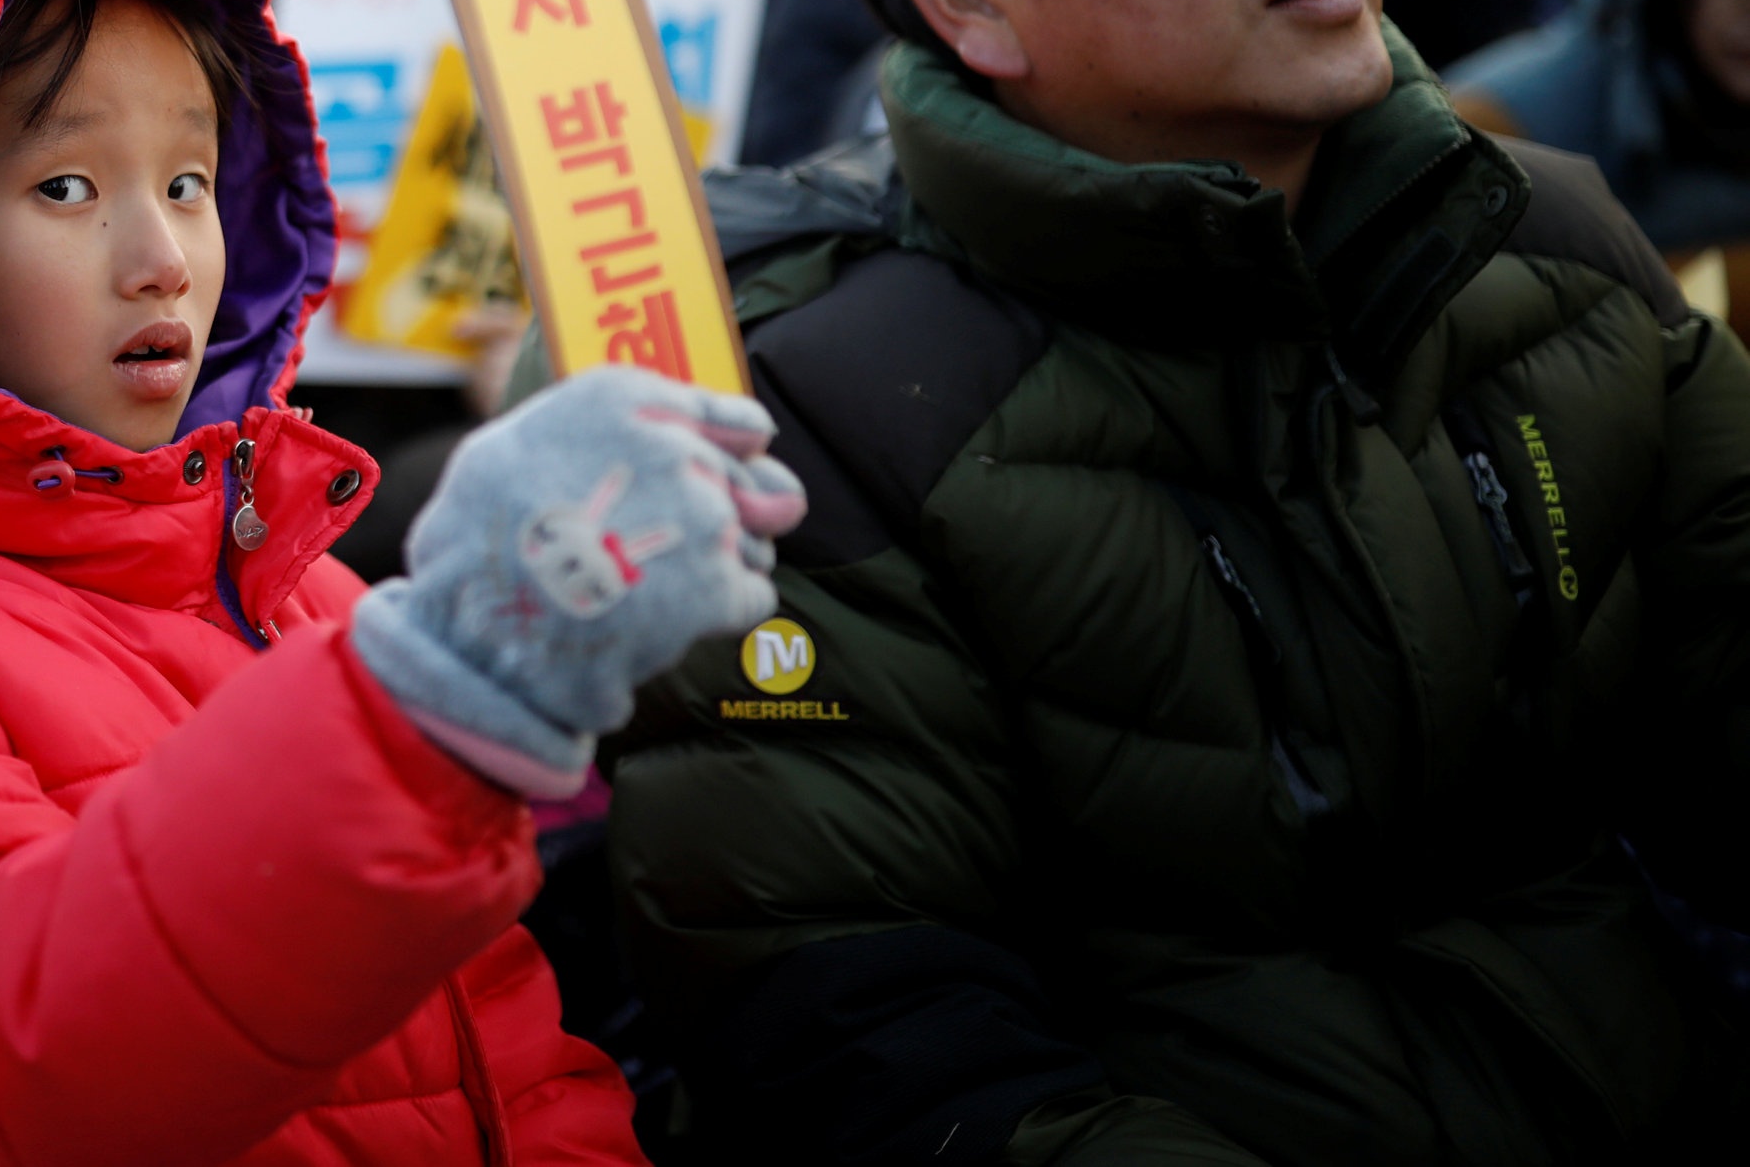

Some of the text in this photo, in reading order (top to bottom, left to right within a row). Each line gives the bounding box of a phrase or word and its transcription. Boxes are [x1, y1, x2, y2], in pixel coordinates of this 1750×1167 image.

[539, 81, 694, 385] 박근혜
[1516, 414, 1570, 567] MERRELL
[720, 700, 850, 720] MERRELL
